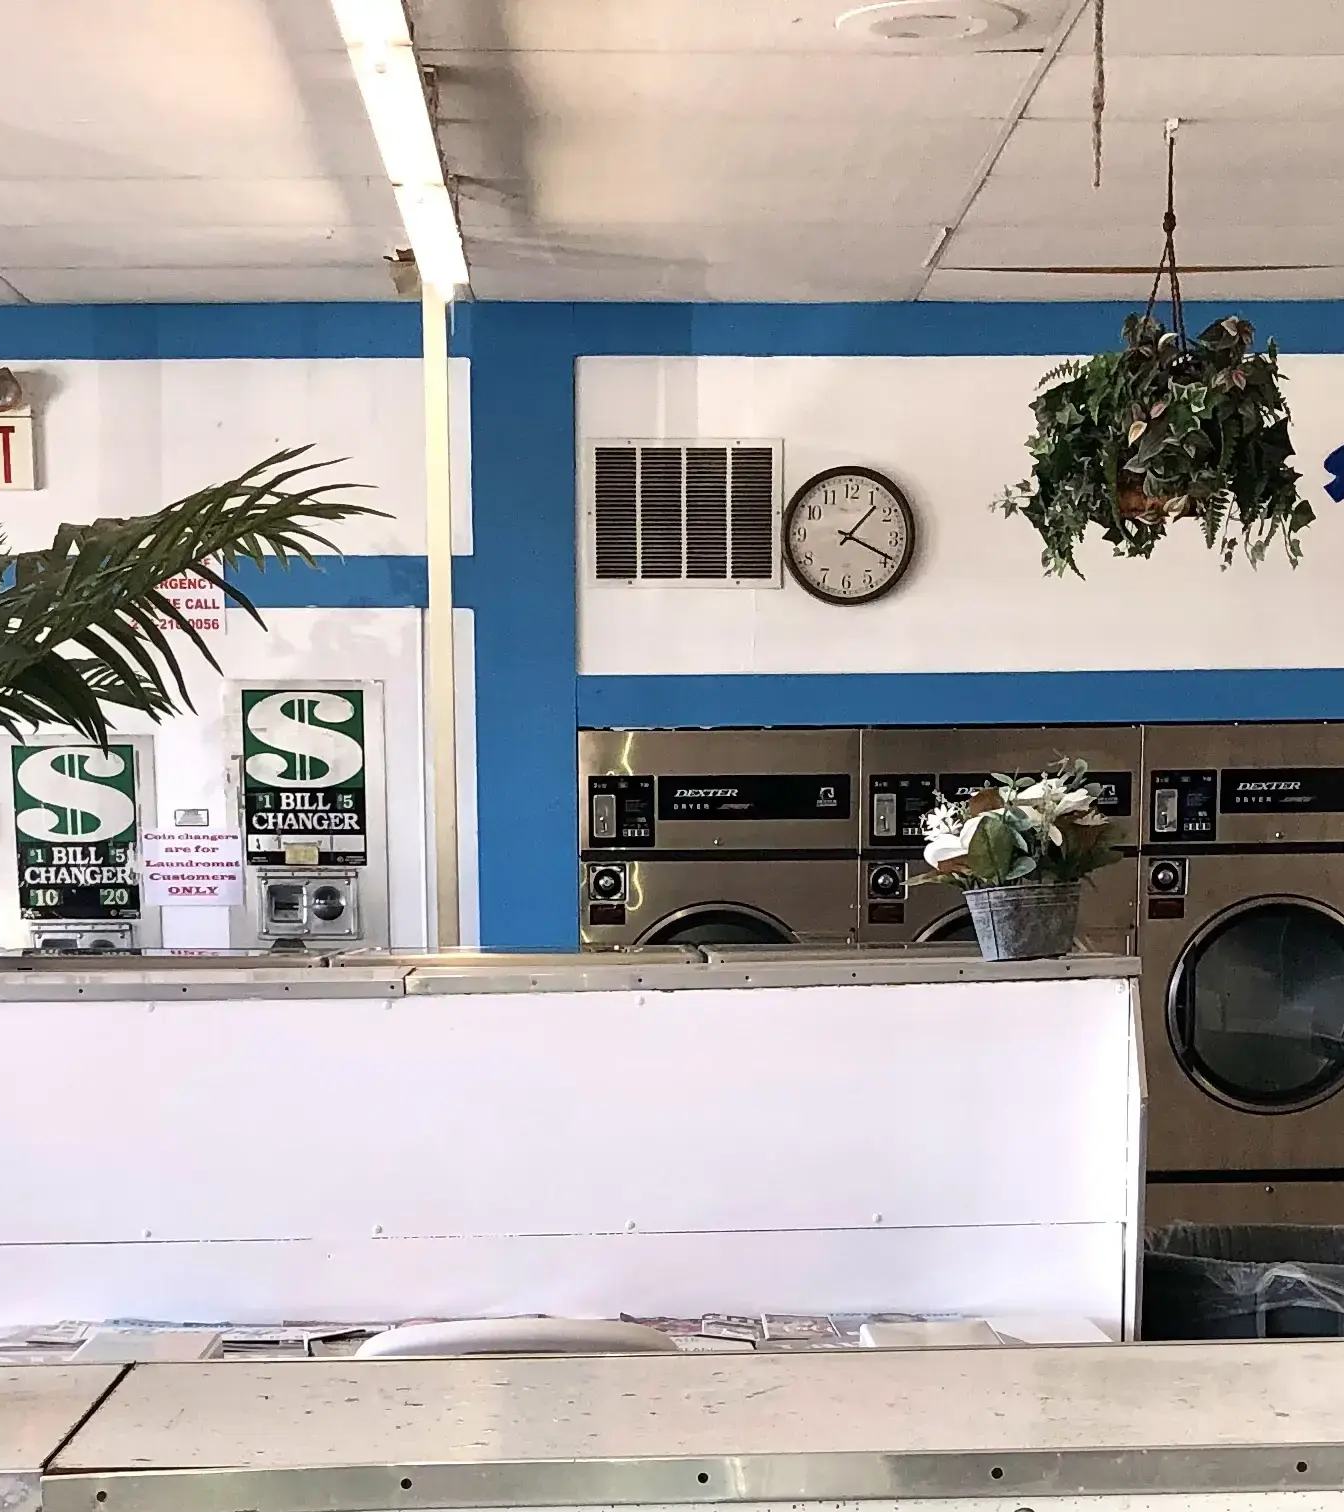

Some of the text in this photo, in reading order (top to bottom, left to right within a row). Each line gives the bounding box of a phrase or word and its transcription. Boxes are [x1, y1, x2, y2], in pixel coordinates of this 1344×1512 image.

[824, 490, 836, 505] 11
[844, 484, 860, 499] 12
[868, 490, 874, 505] 1
[807, 505, 822, 520] 10
[882, 507, 892, 522] 2
[797, 527, 807, 542] 9
[889, 531, 899, 547] 3
[803, 551, 814, 566] 8
[820, 568, 830, 583] 7
[842, 574, 851, 589] 6
[862, 569, 873, 584] 5
[185, 598, 220, 610] CALL
[674, 788, 739, 798] DEXTER
[1237, 781, 1301, 791] DEXTER
[279, 792, 331, 810] BILL
[252, 812, 361, 830] CHANGER
[178, 832, 239, 841] changers
[52, 846, 104, 865] BILL
[194, 845, 219, 853] for
[24, 866, 134, 885] CHANGER
[149, 872, 237, 881] Customers
[168, 886, 219, 895] ONLY
